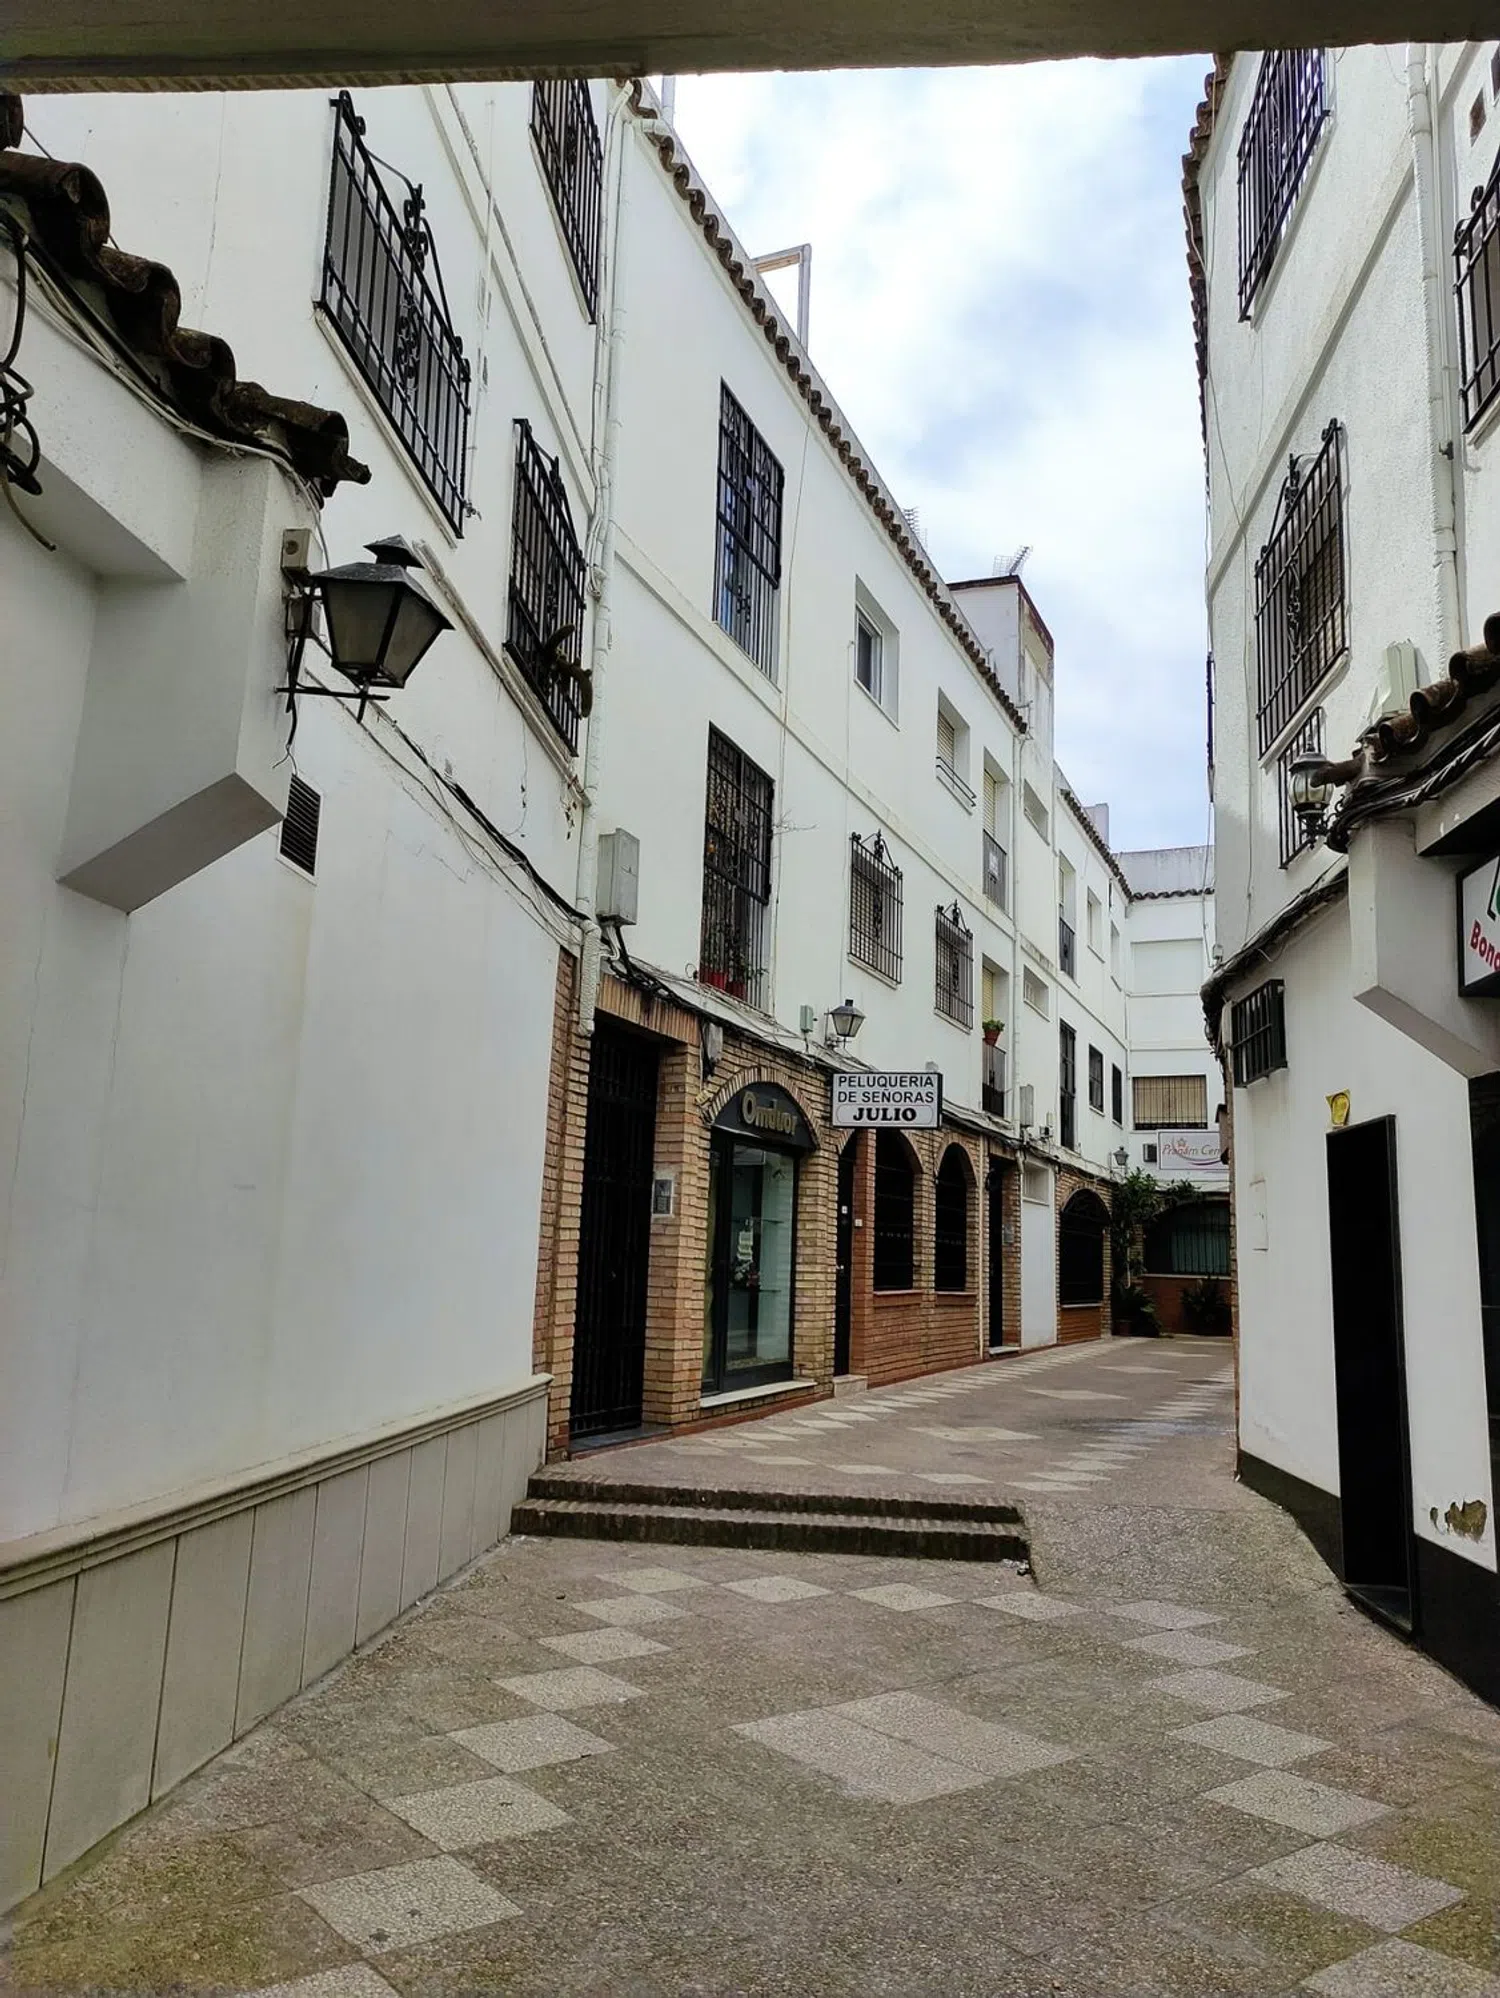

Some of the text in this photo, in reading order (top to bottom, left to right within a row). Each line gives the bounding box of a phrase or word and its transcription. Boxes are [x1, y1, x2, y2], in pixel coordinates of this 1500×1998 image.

[838, 1076, 934, 1088] PELUQUERIA
[838, 1088, 934, 1103] DE SEÑORAS
[853, 1107, 917, 1121] JULIO
